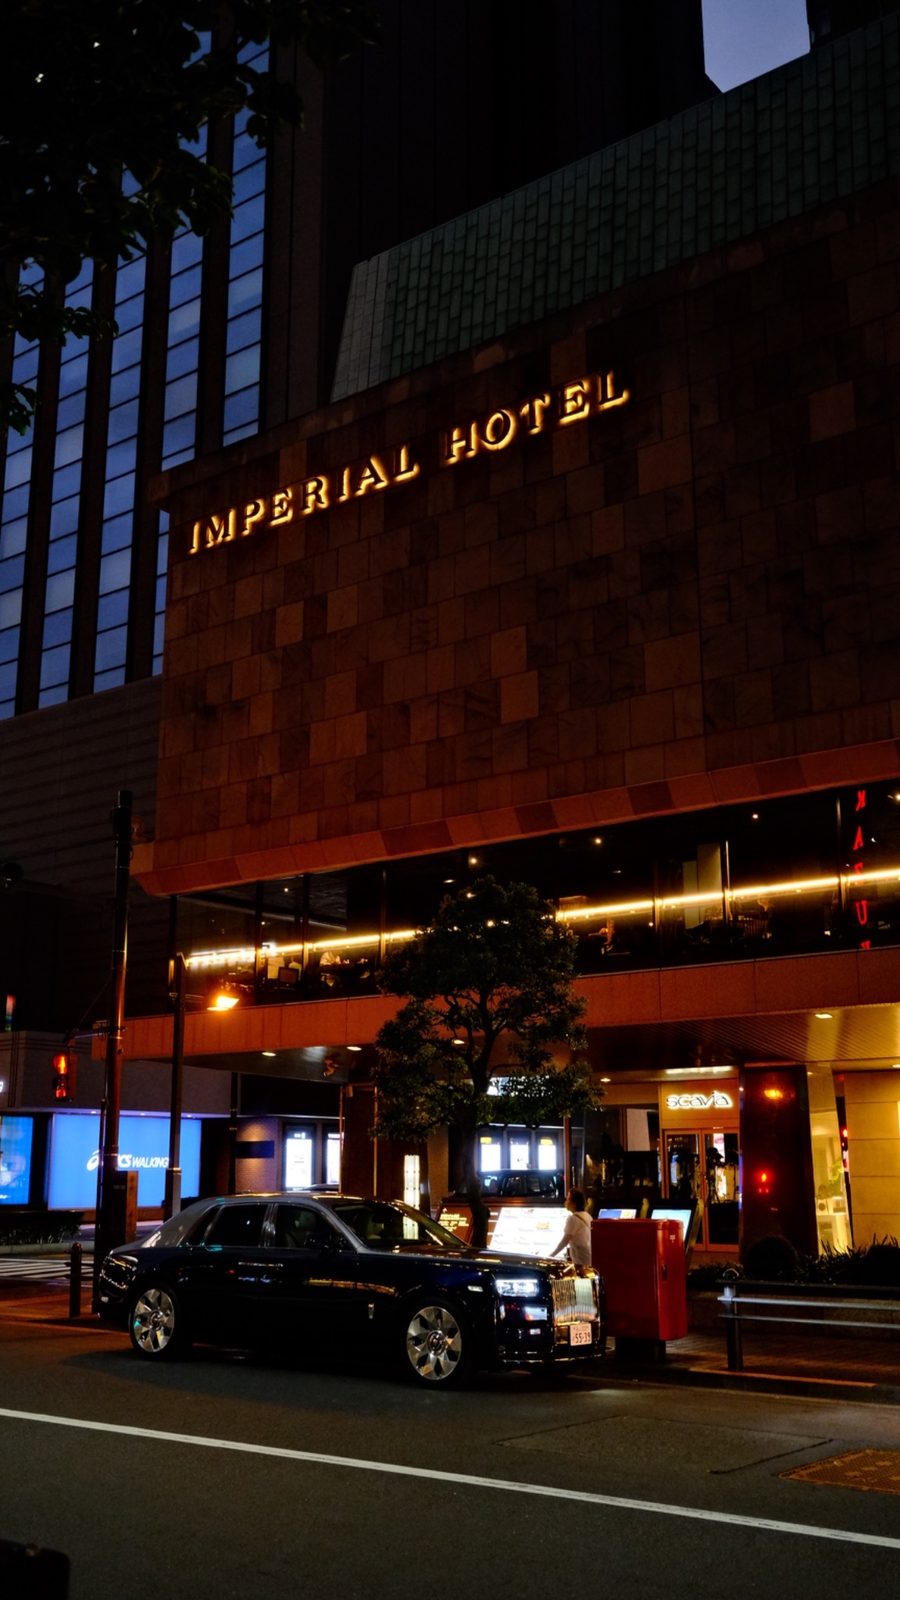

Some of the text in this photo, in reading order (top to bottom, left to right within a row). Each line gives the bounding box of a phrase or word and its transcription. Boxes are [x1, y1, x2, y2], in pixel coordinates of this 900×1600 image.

[187, 370, 631, 555] IMPERIAL HOTEL
[666, 1091, 733, 1108] scavia
[132, 1156, 169, 1168] WALKING
